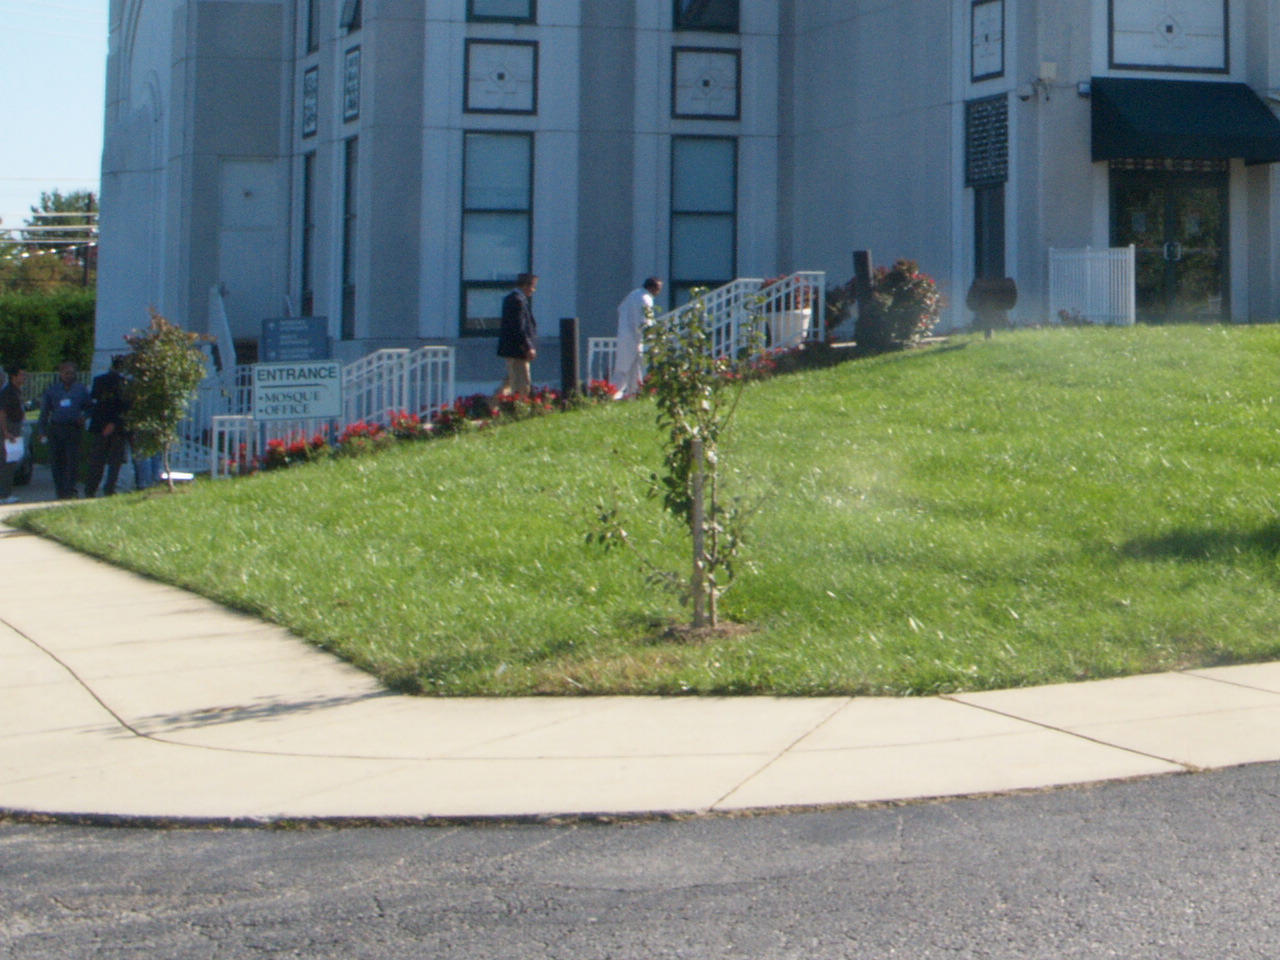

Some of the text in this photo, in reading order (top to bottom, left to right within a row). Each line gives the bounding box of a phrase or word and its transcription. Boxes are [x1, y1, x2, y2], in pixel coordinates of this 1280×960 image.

[257, 366, 337, 381] ENTRANCE
[265, 391, 320, 403] MOSQUE
[265, 404, 309, 415] OFFICE
